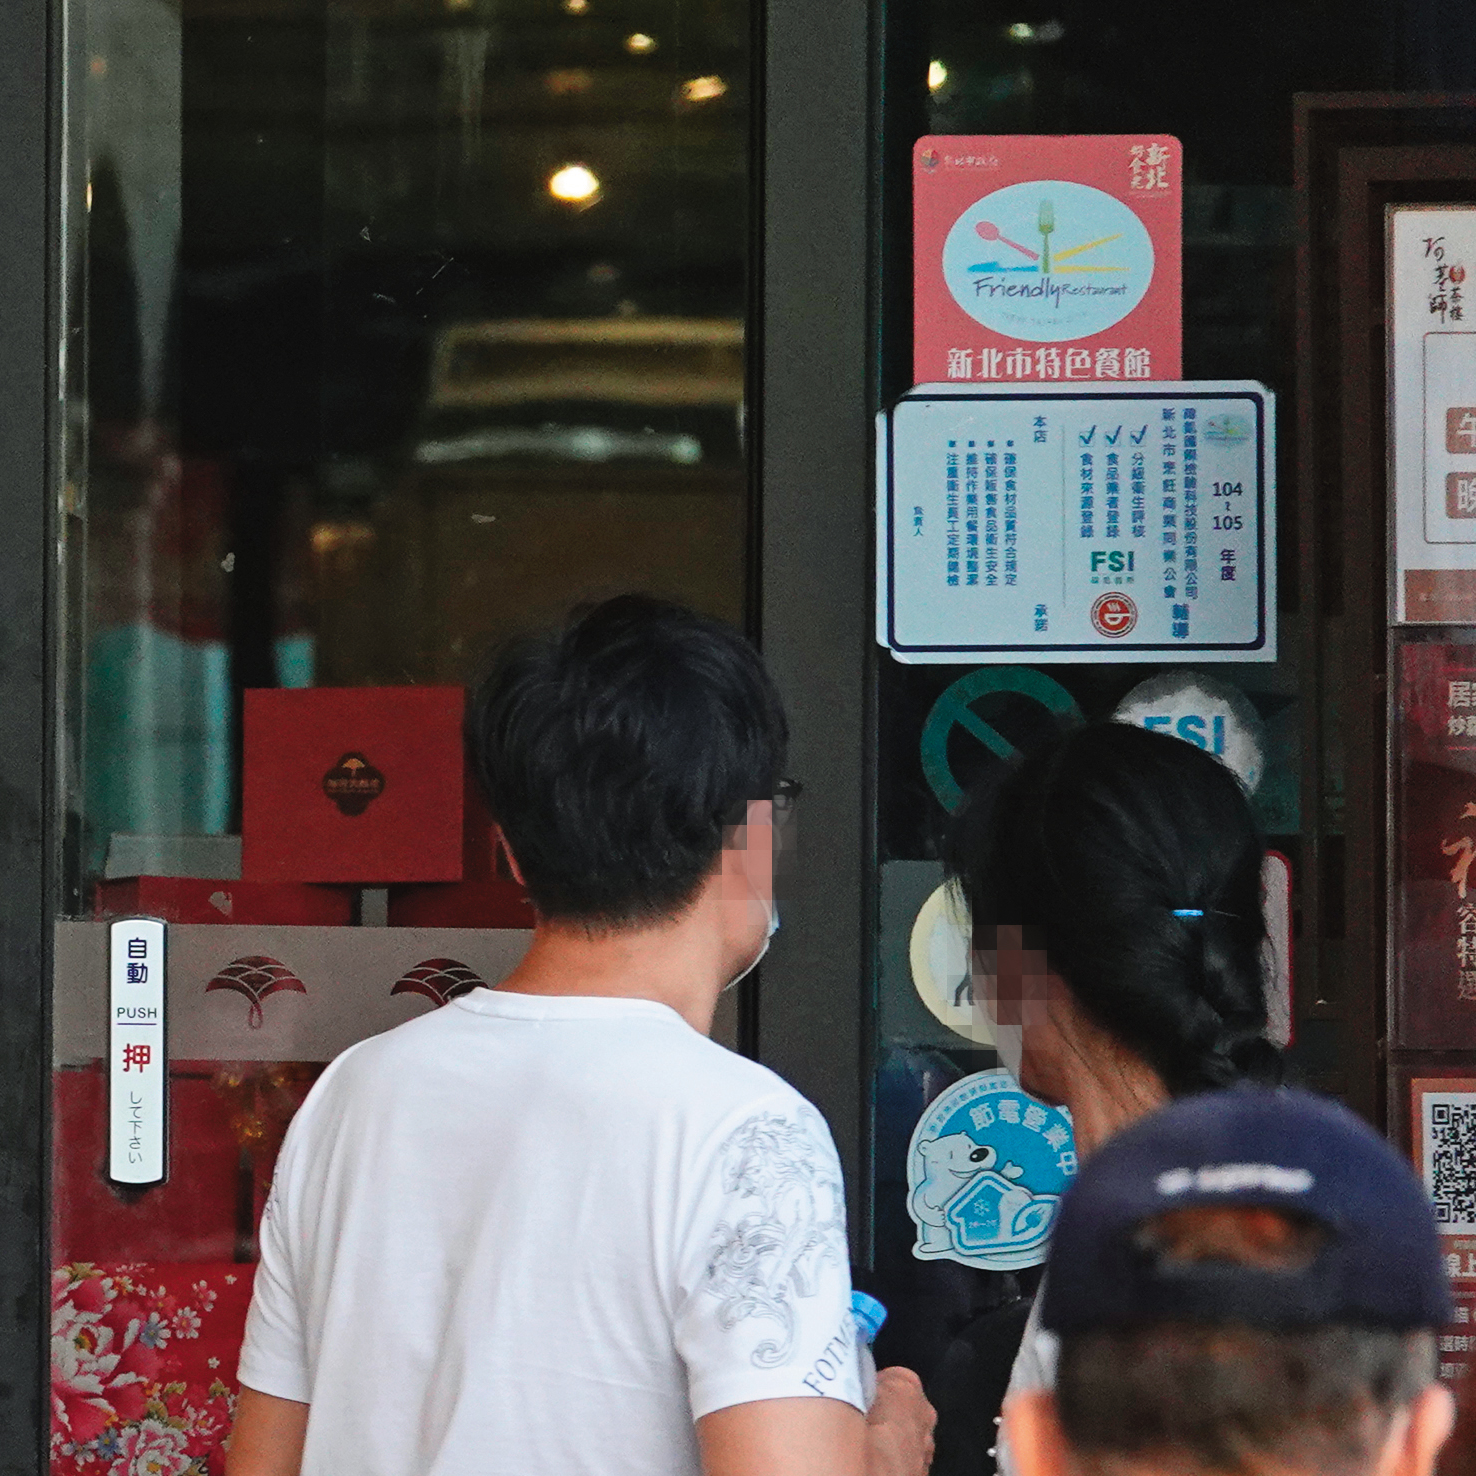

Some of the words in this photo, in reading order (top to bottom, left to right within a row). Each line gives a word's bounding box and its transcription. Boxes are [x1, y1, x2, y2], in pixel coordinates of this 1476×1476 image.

[973, 276, 1061, 309] Friendly
[1061, 282, 1128, 296] Restaurant
[946, 347, 1152, 380] 新北市特色餐館
[1212, 481, 1243, 498] 104
[1212, 515, 1244, 531] 105
[1090, 551, 1135, 572] FSI
[126, 937, 148, 984] 自動
[117, 1007, 157, 1019] PUSH
[122, 1043, 151, 1073] 押
[128, 1090, 143, 1164] して下さい
